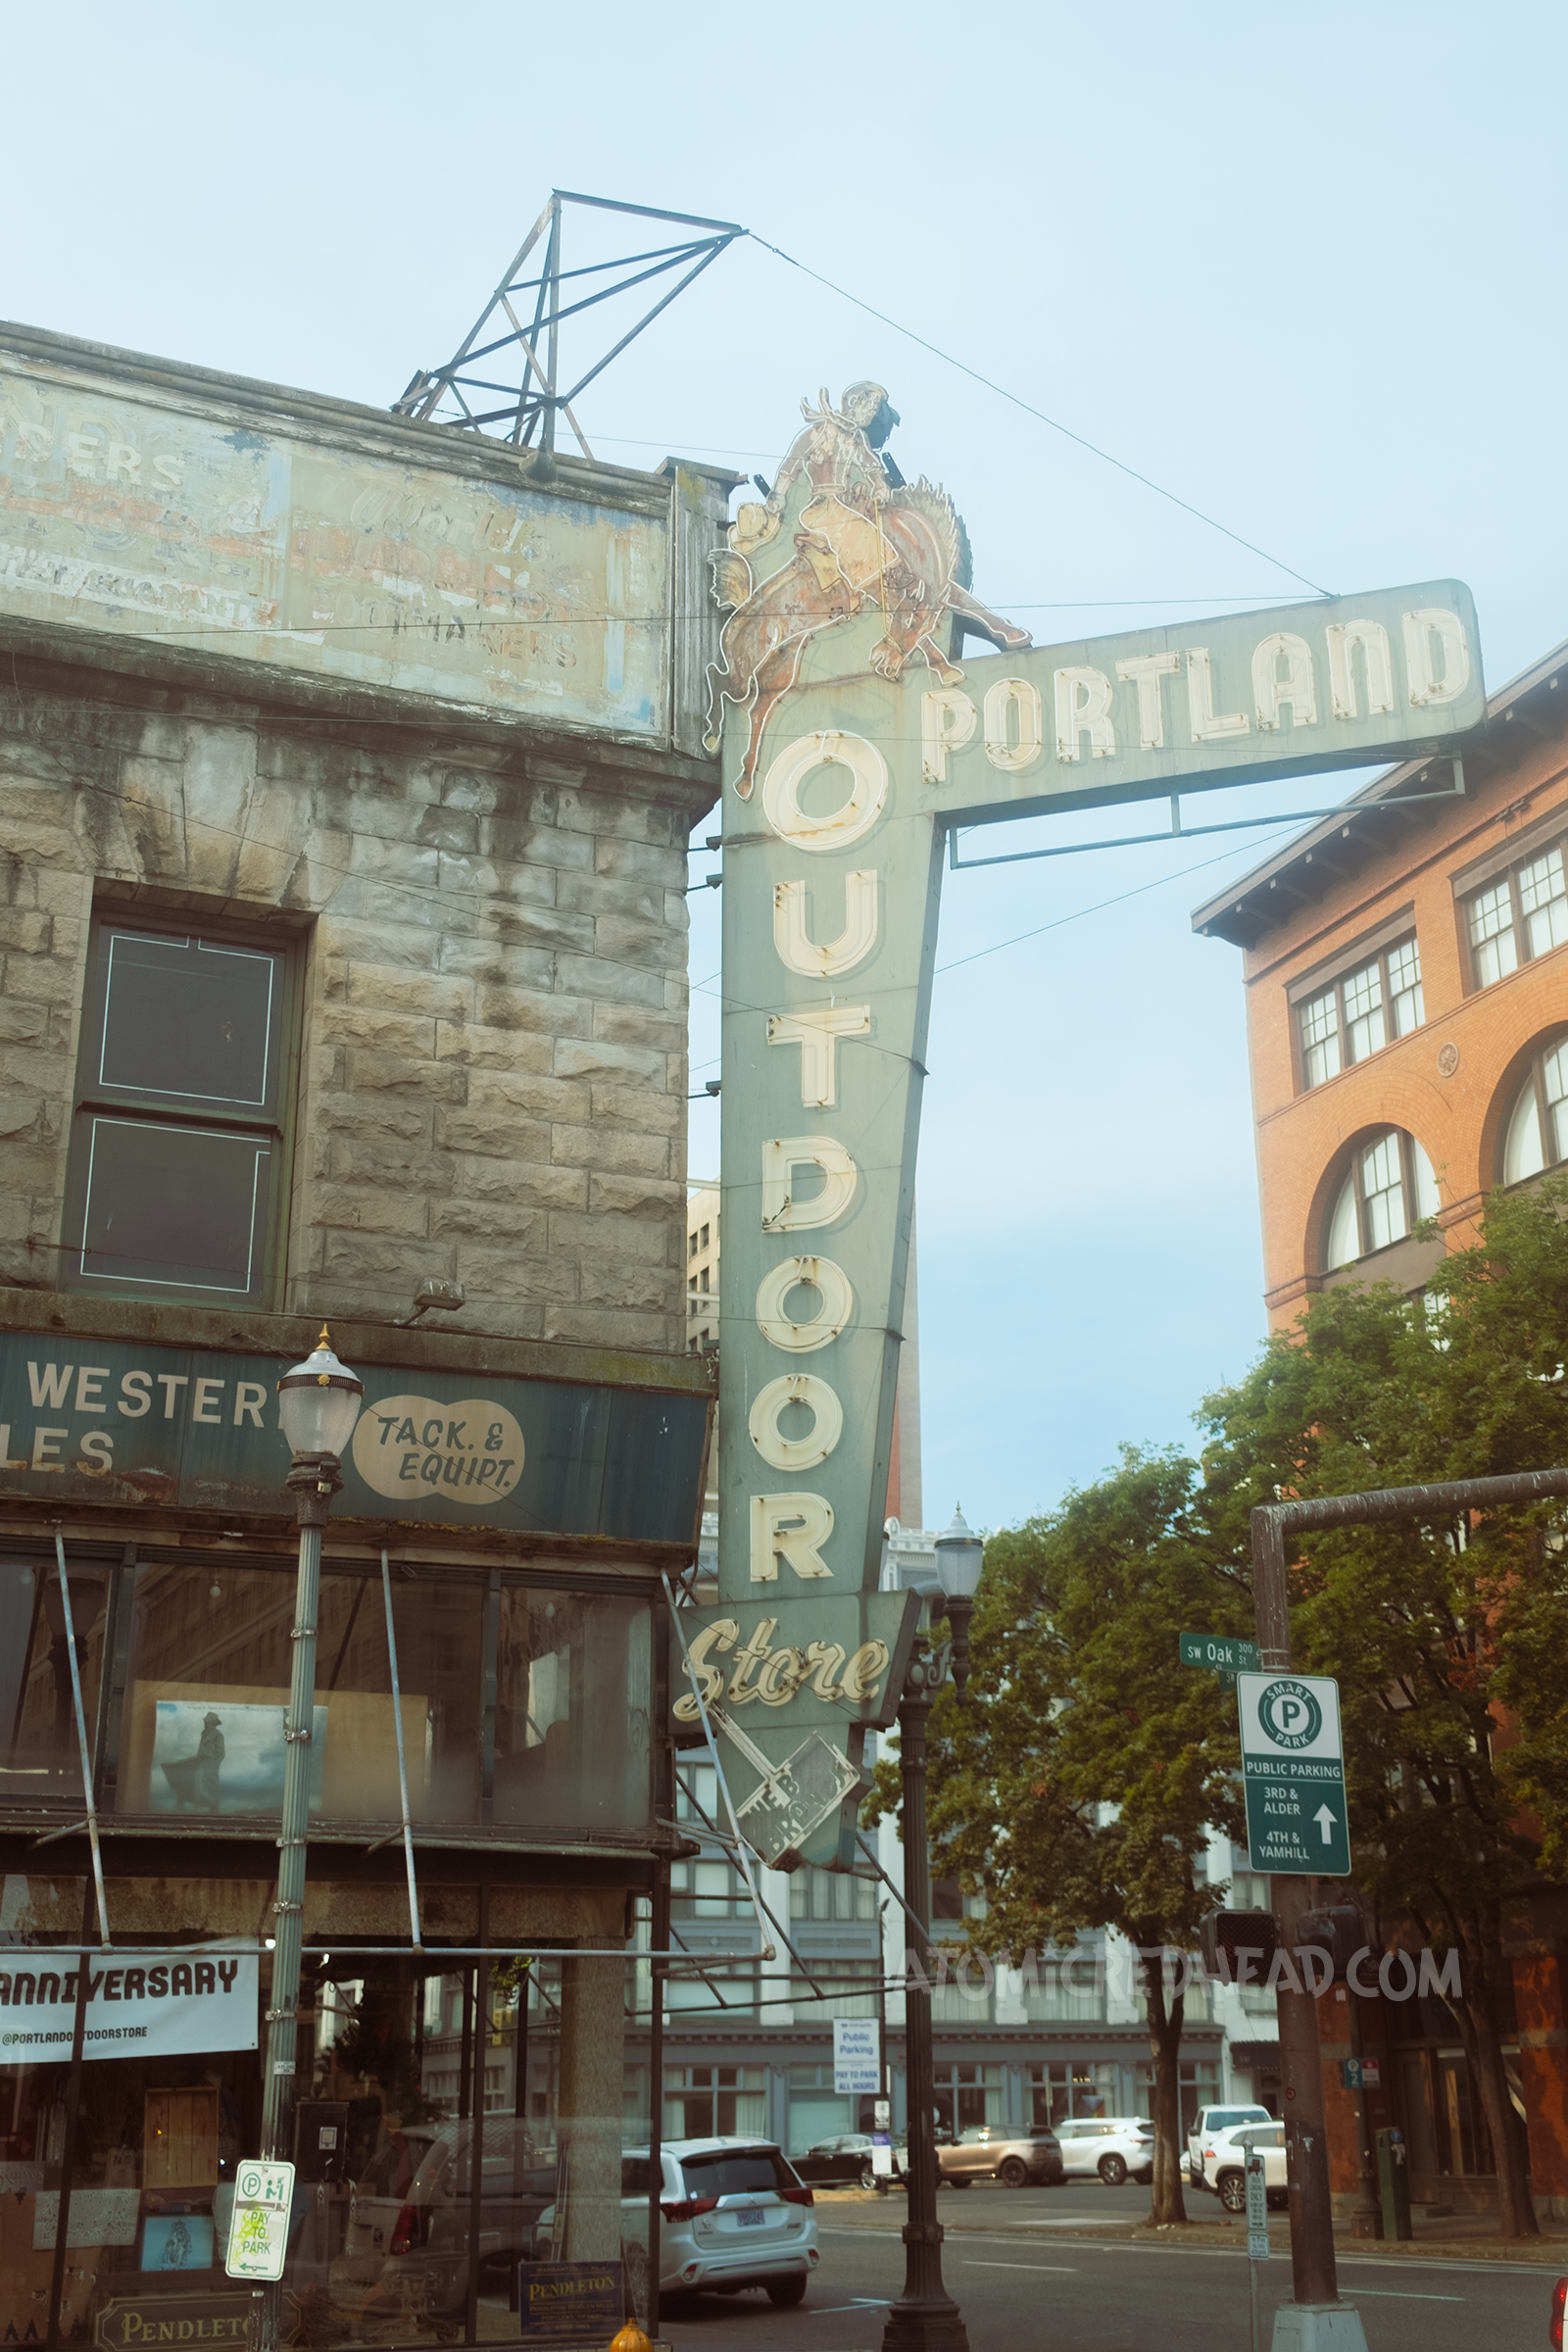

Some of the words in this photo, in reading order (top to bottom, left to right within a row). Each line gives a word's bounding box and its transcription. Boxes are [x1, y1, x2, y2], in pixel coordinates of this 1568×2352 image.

[0, 417, 186, 491] DERS
[921, 609, 1471, 783] PORTLAND
[749, 730, 889, 1583] OUTDOOR
[26, 1361, 284, 1430] WESTER
[378, 1417, 474, 1450] TACK.
[484, 1422, 504, 1451] &
[398, 1452, 515, 1488] EQUIPT.
[1206, 1642, 1233, 1664] Oak
[1238, 1642, 1253, 1654] 300
[1238, 1654, 1248, 1665] St
[672, 1617, 890, 1722] Store
[1266, 1682, 1312, 1702] SMART
[1281, 1699, 1300, 1729] P
[1275, 1733, 1310, 1748] PARK
[1247, 1761, 1288, 1776] PUBLIC
[1291, 1763, 1341, 1779] PARKING
[1263, 1787, 1287, 1799] 3RD
[1289, 1788, 1298, 1800] &
[1263, 1802, 1301, 1815] ALDER
[1266, 1831, 1289, 1843] 4TH
[1292, 1832, 1300, 1844] &
[1258, 1845, 1310, 1860] YAMHILL
[2, 2026, 148, 2045] @PORTLANDOTDOORSTORE
[842, 2032, 870, 2042] Public
[840, 2044, 874, 2056] Parking
[835, 2070, 849, 2080] PAY
[850, 2070, 859, 2079] TO
[859, 2070, 878, 2079] PARK
[838, 2082, 851, 2090] ALL
[853, 2082, 876, 2090] HOURS
[250, 2211, 271, 2226] PAY
[252, 2226, 267, 2239] TO
[242, 2240, 272, 2255] PARK
[528, 2276, 615, 2301] PENDLETON
[121, 2311, 249, 2343] PENDLET
